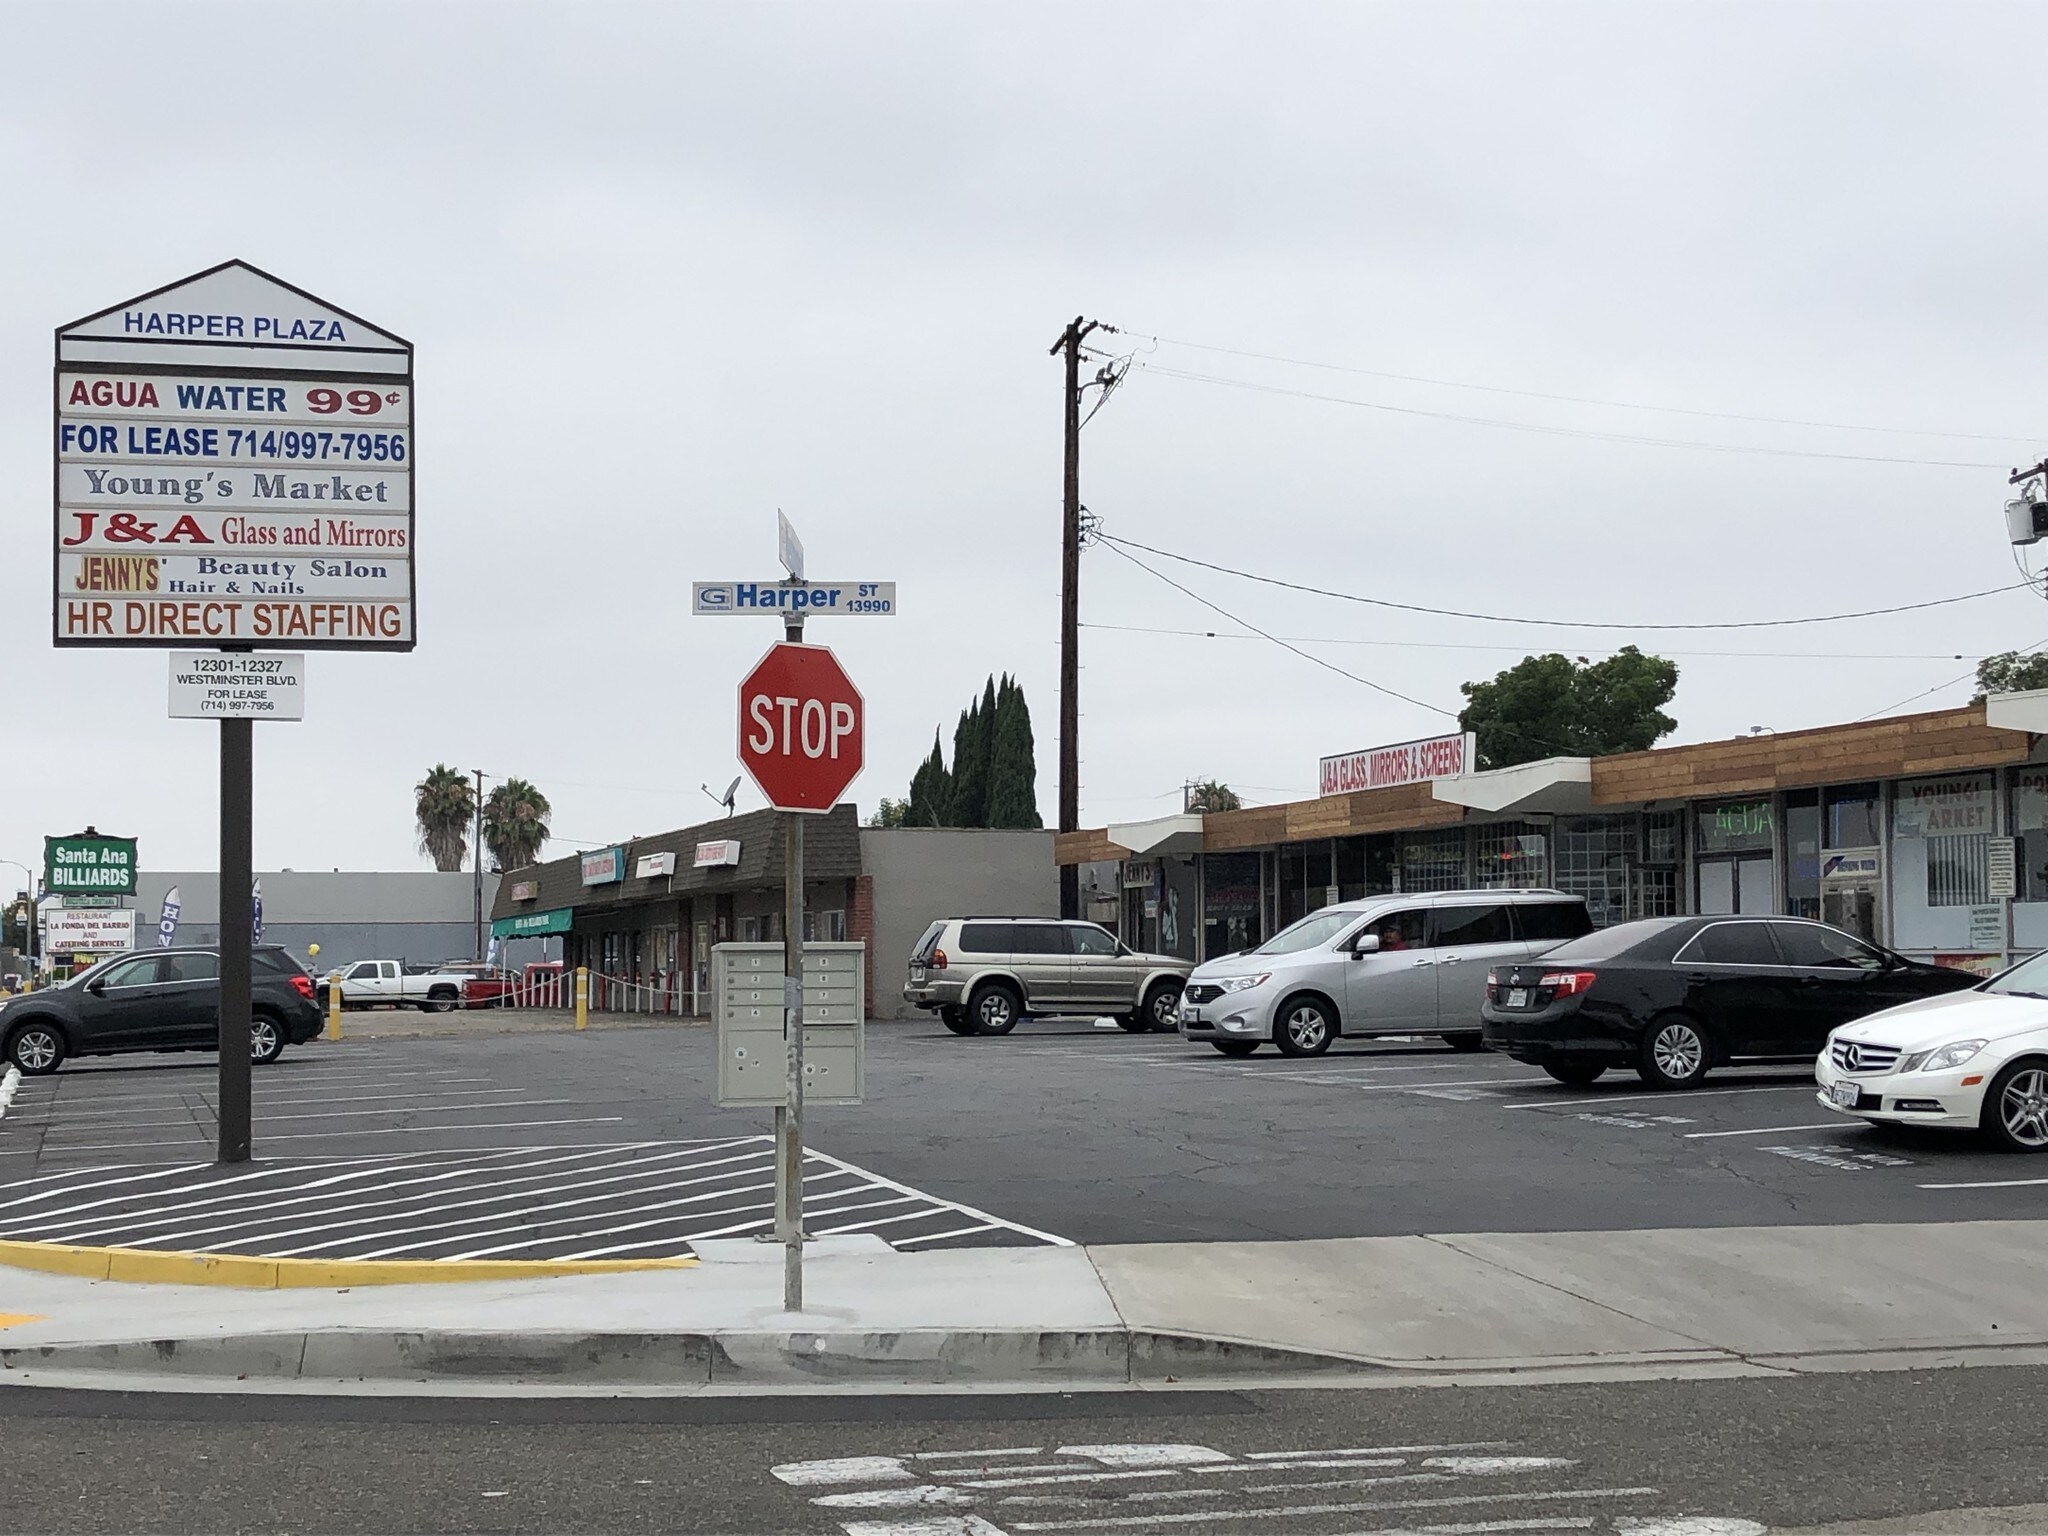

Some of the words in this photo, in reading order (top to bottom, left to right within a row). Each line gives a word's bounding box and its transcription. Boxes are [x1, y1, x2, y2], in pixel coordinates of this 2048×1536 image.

[124, 312, 244, 337] HARPER
[254, 317, 346, 342] PLAZA
[68, 380, 160, 408] AGUA
[176, 385, 287, 413] WATER
[61, 424, 119, 454] FOR
[128, 426, 219, 457] LEASE
[227, 430, 405, 462] 714/997-7956
[84, 469, 234, 503] Young's
[253, 473, 388, 502] Market
[63, 513, 215, 546] J&A
[221, 517, 277, 545] Glass
[283, 518, 321, 545] and
[326, 520, 406, 548] Mirrors
[198, 557, 297, 580] Beauty
[310, 560, 388, 579] Salon
[169, 580, 217, 594] Hair
[225, 581, 241, 594] &
[251, 581, 305, 595] Nails
[737, 584, 841, 611] Harper
[858, 584, 879, 597] ST
[846, 600, 891, 613] 13990
[68, 602, 114, 635] HR
[126, 602, 242, 636] DIRECT
[253, 603, 401, 637] STAFFING
[193, 659, 283, 673] 12301-12327
[177, 674, 263, 686] WESTMINSTER
[266, 676, 298, 686] BLVD.
[208, 689, 230, 699] FOR
[233, 690, 268, 699] LEASE
[201, 701, 227, 711] (714)
[229, 701, 275, 711] 997-7956
[748, 694, 855, 759] STOP
[1321, 761, 1338, 794] J&A
[1370, 748, 1409, 787] MIRRORS
[1411, 747, 1418, 780] &
[1420, 739, 1462, 778] SCREENS
[55, 847, 97, 864] Santa
[100, 848, 128, 864] Ana
[53, 867, 129, 886] BILLIARDS
[66, 912, 112, 920] RESTAURANT
[50, 922, 60, 930] LA
[54, 940, 90, 948] CATERING
